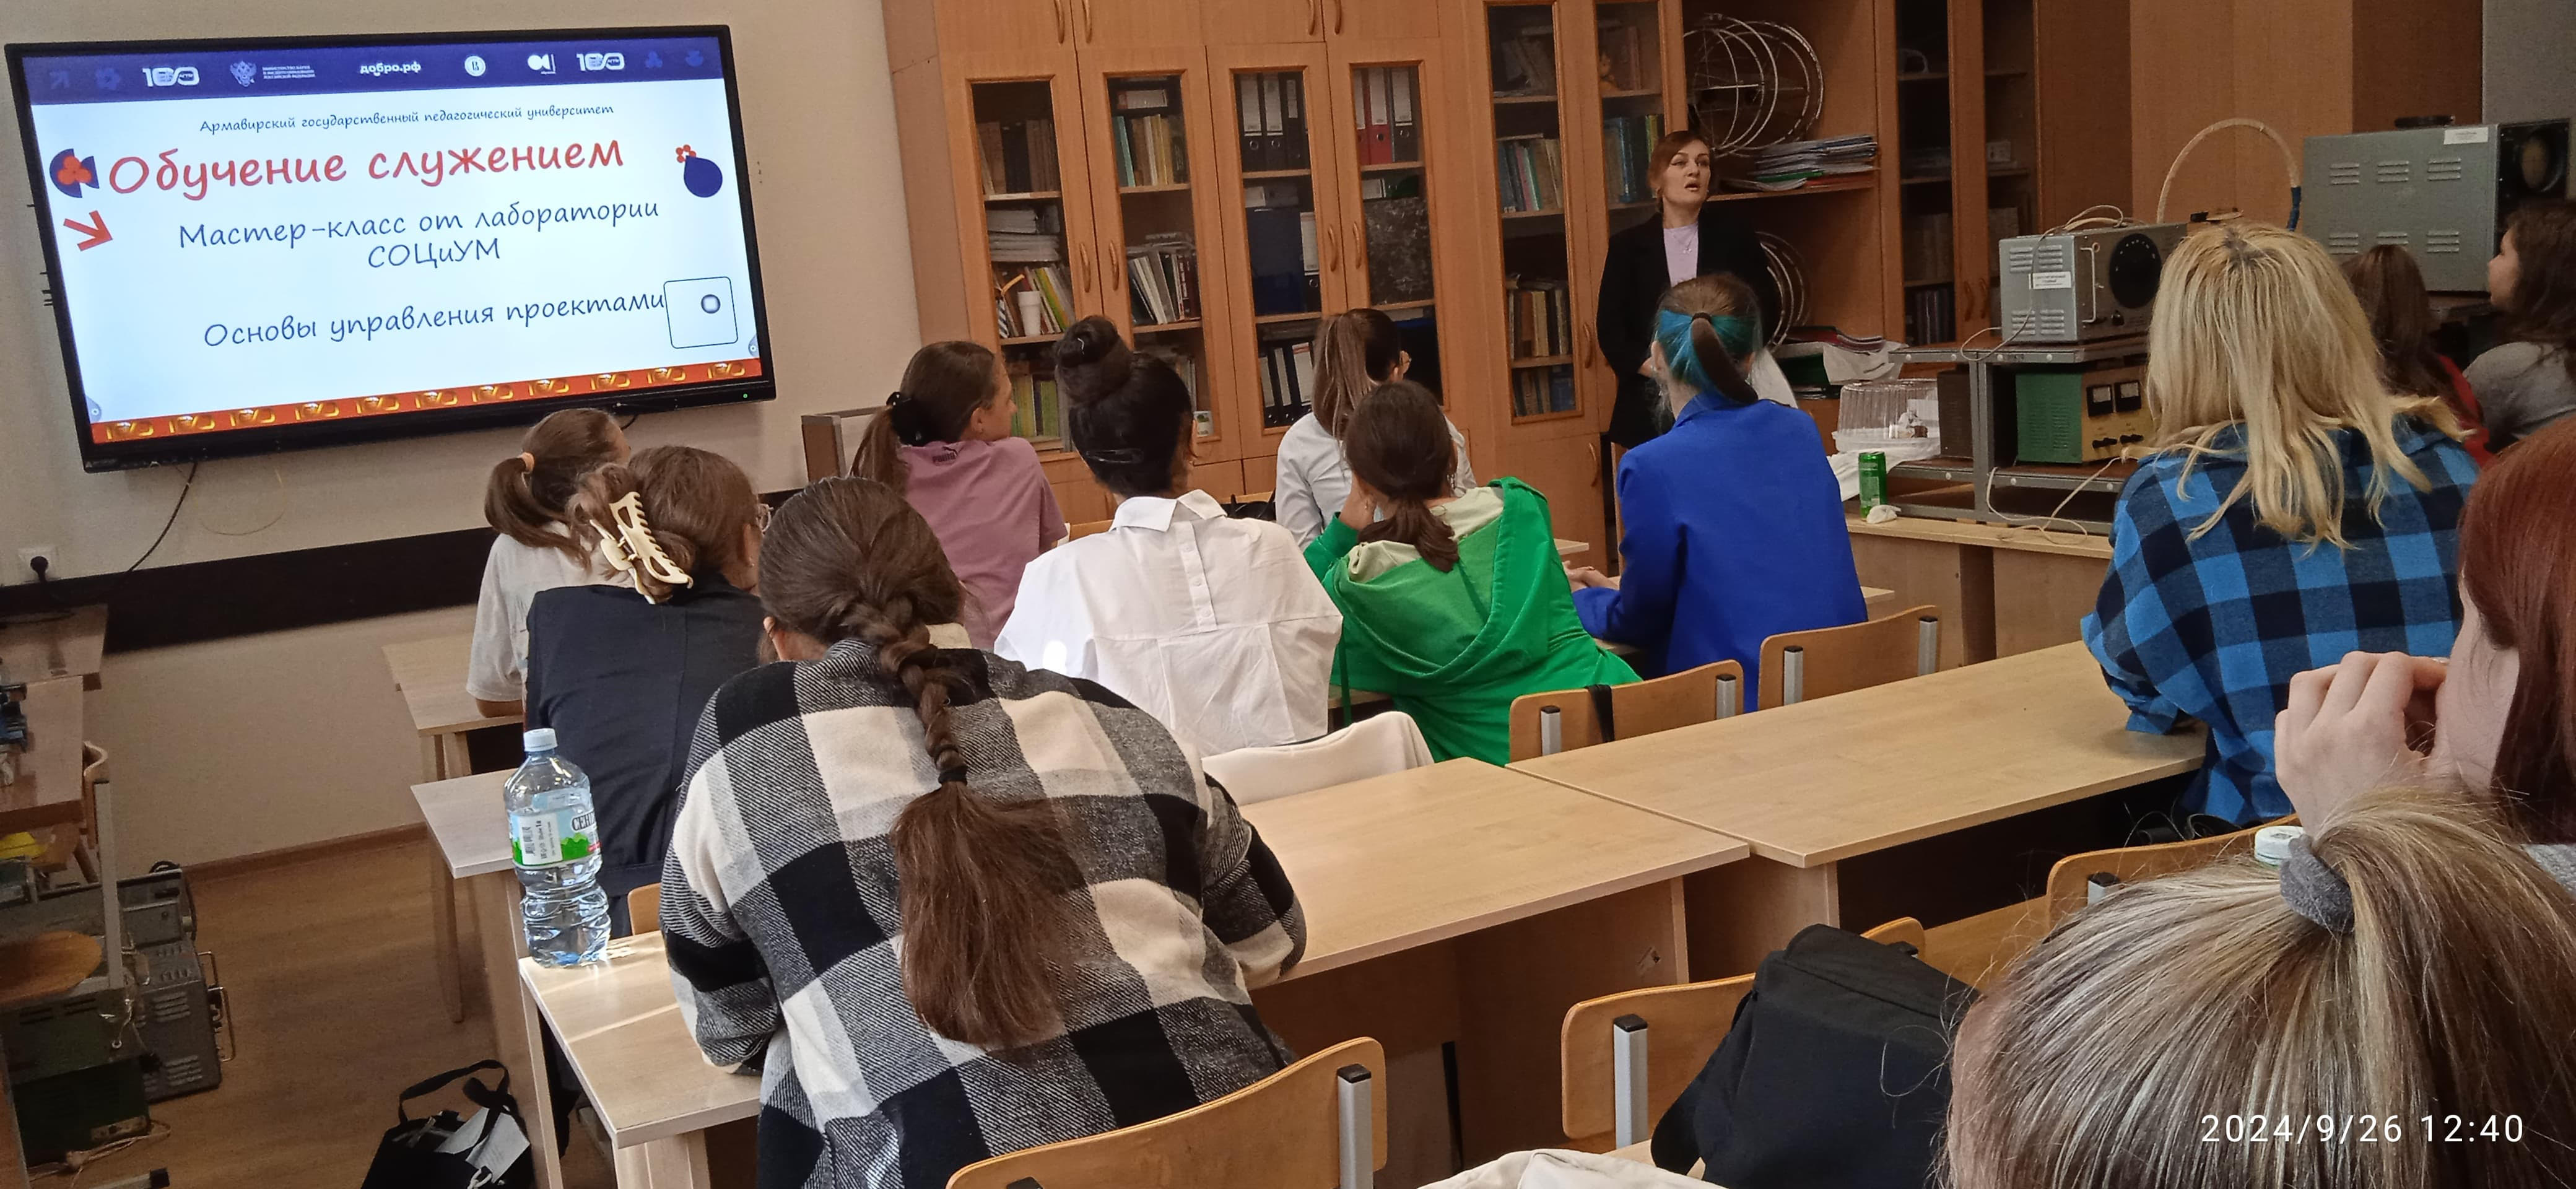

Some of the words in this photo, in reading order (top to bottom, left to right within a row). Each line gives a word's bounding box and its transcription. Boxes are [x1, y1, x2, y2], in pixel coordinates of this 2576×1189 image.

[360, 61, 421, 76] добро.рф
[200, 118, 295, 135] Армавирский
[302, 112, 419, 129] государственный
[425, 107, 521, 121] педагогический
[528, 105, 613, 120] университет
[110, 149, 346, 201] Обучение
[369, 140, 623, 186] служением
[180, 218, 406, 249] Мастер-класс
[420, 216, 463, 231] от
[476, 201, 658, 232] лаборатории
[368, 238, 500, 268] СОЦиУМ
[205, 315, 316, 346] Основы
[331, 306, 493, 342] управления
[507, 294, 664, 327] проектами
